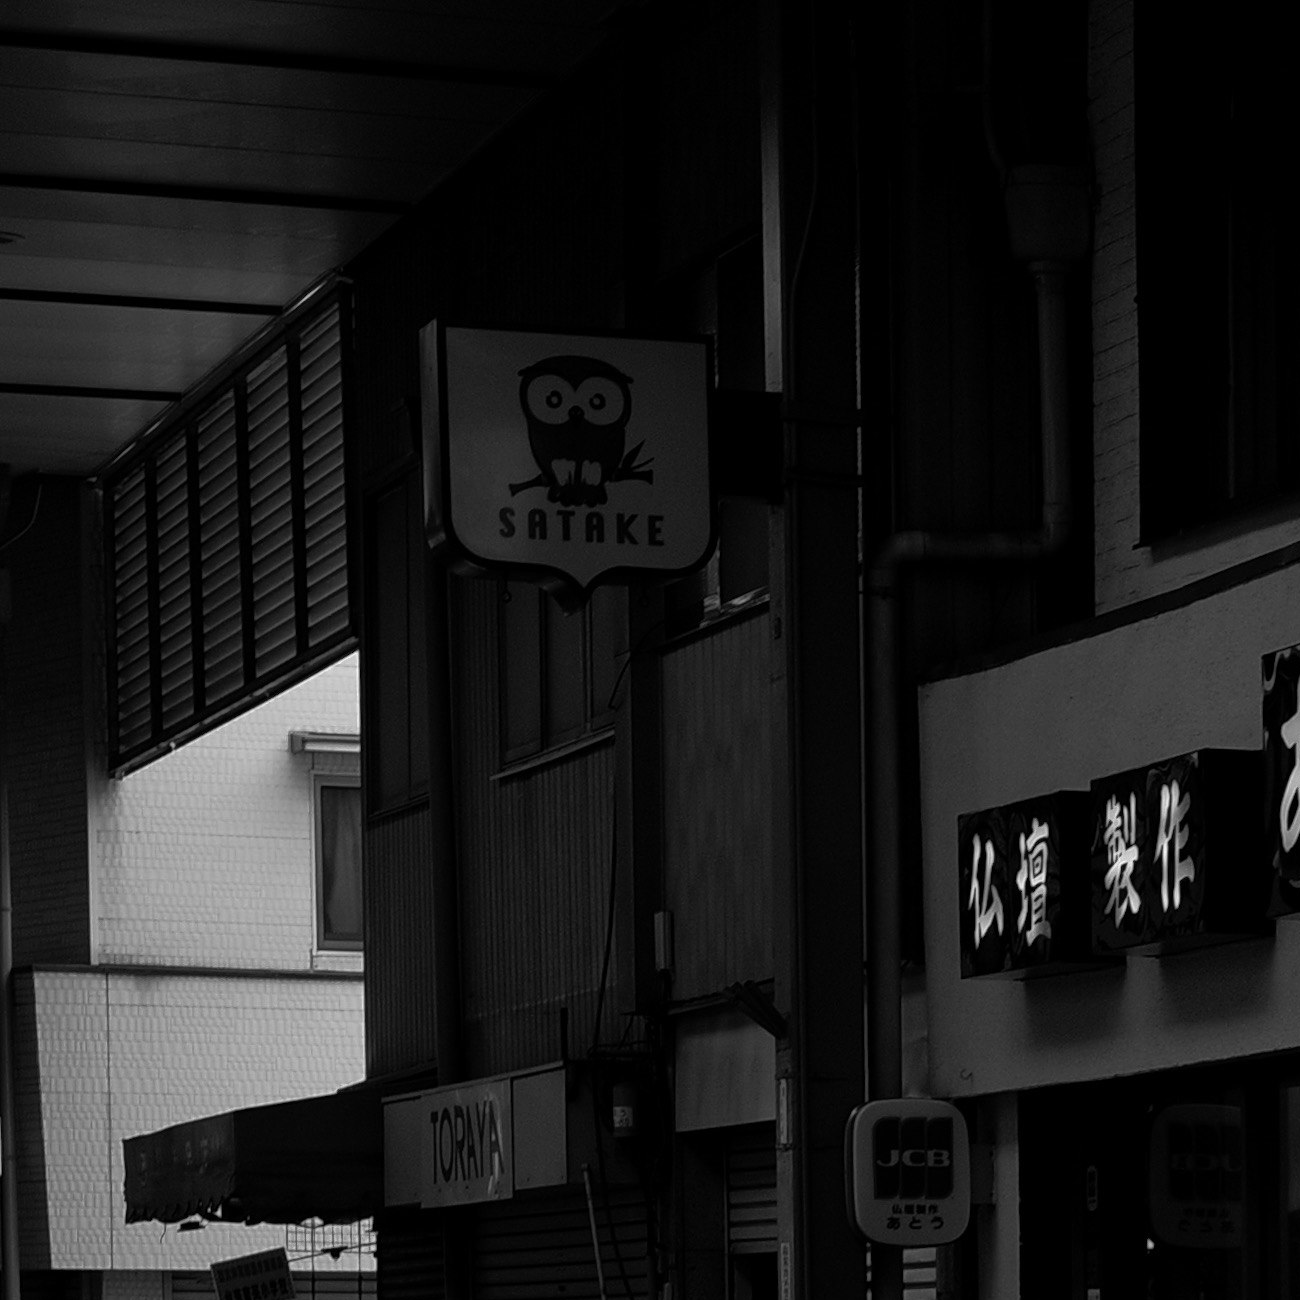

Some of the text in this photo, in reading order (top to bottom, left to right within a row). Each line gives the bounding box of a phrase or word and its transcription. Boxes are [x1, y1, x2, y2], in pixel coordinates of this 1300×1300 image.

[499, 506, 665, 546] SATAKE
[430, 1100, 505, 1185] TORAYA
[876, 1149, 952, 1168] JCB
[886, 1216, 944, 1230] あとう
